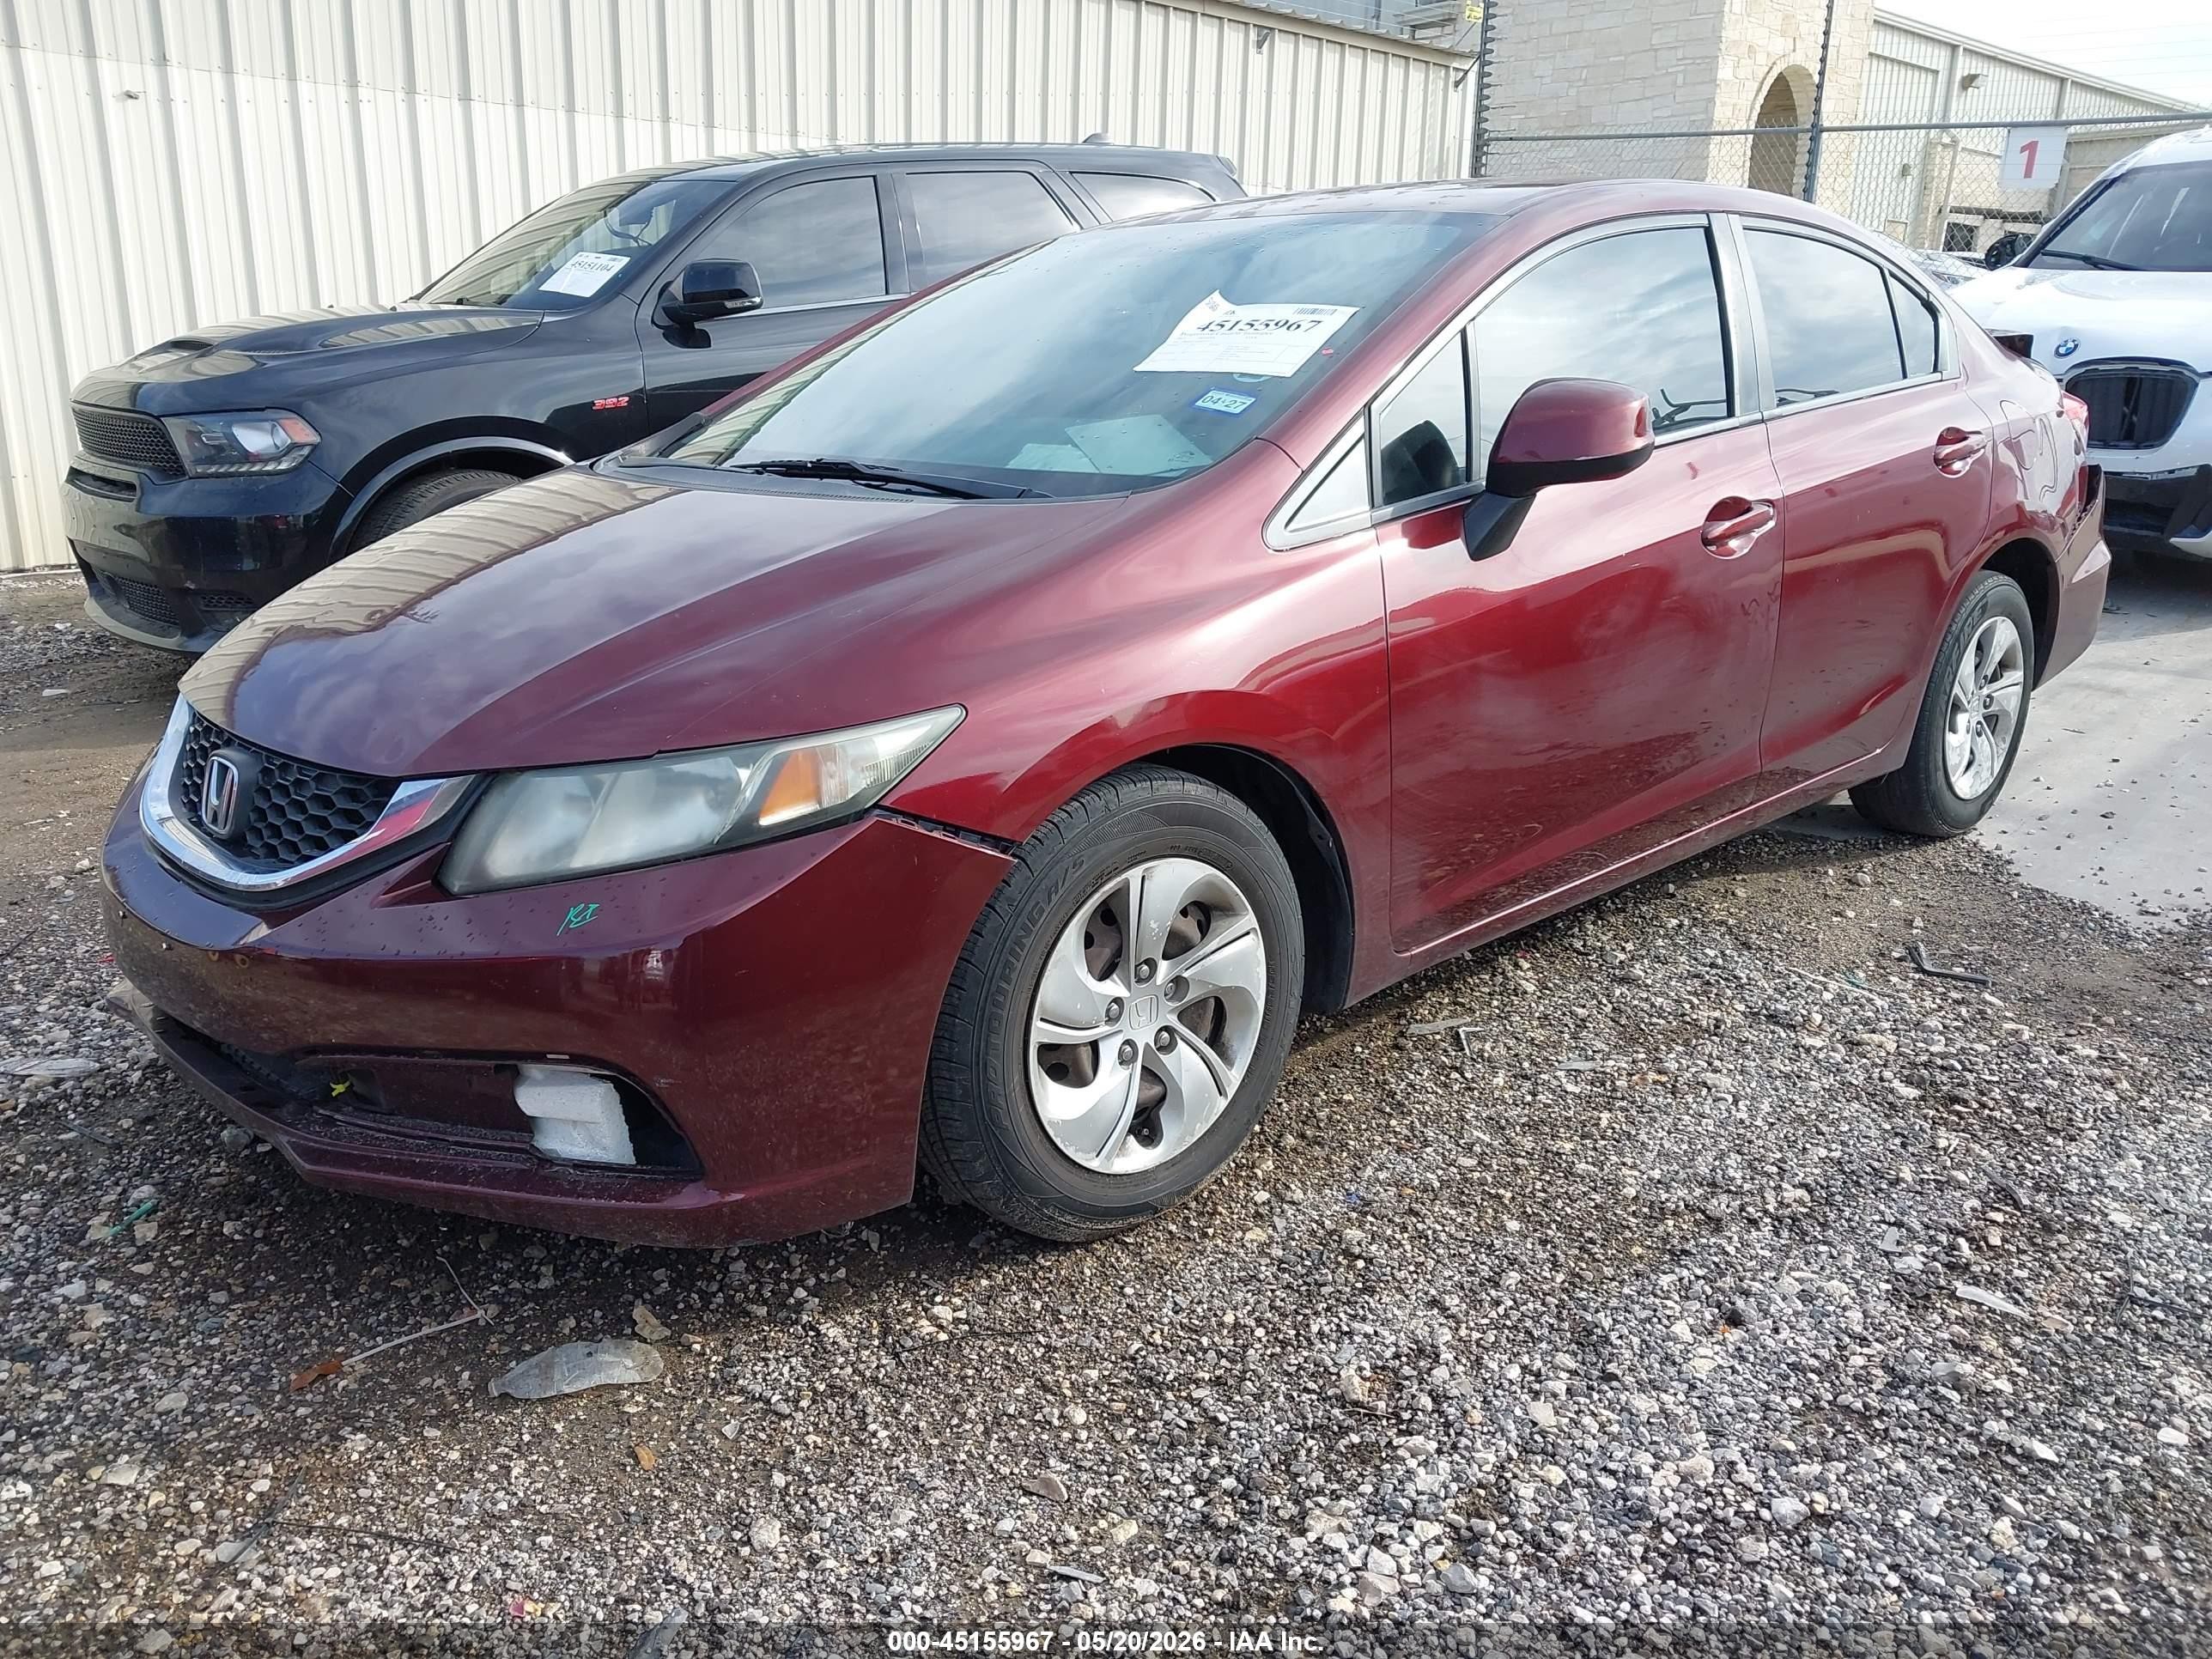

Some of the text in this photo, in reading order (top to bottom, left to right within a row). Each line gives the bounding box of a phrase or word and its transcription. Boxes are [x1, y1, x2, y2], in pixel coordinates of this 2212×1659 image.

[2020, 140, 2039, 179] 1
[1197, 319, 1323, 332] 45155967
[592, 397, 629, 410] 392
